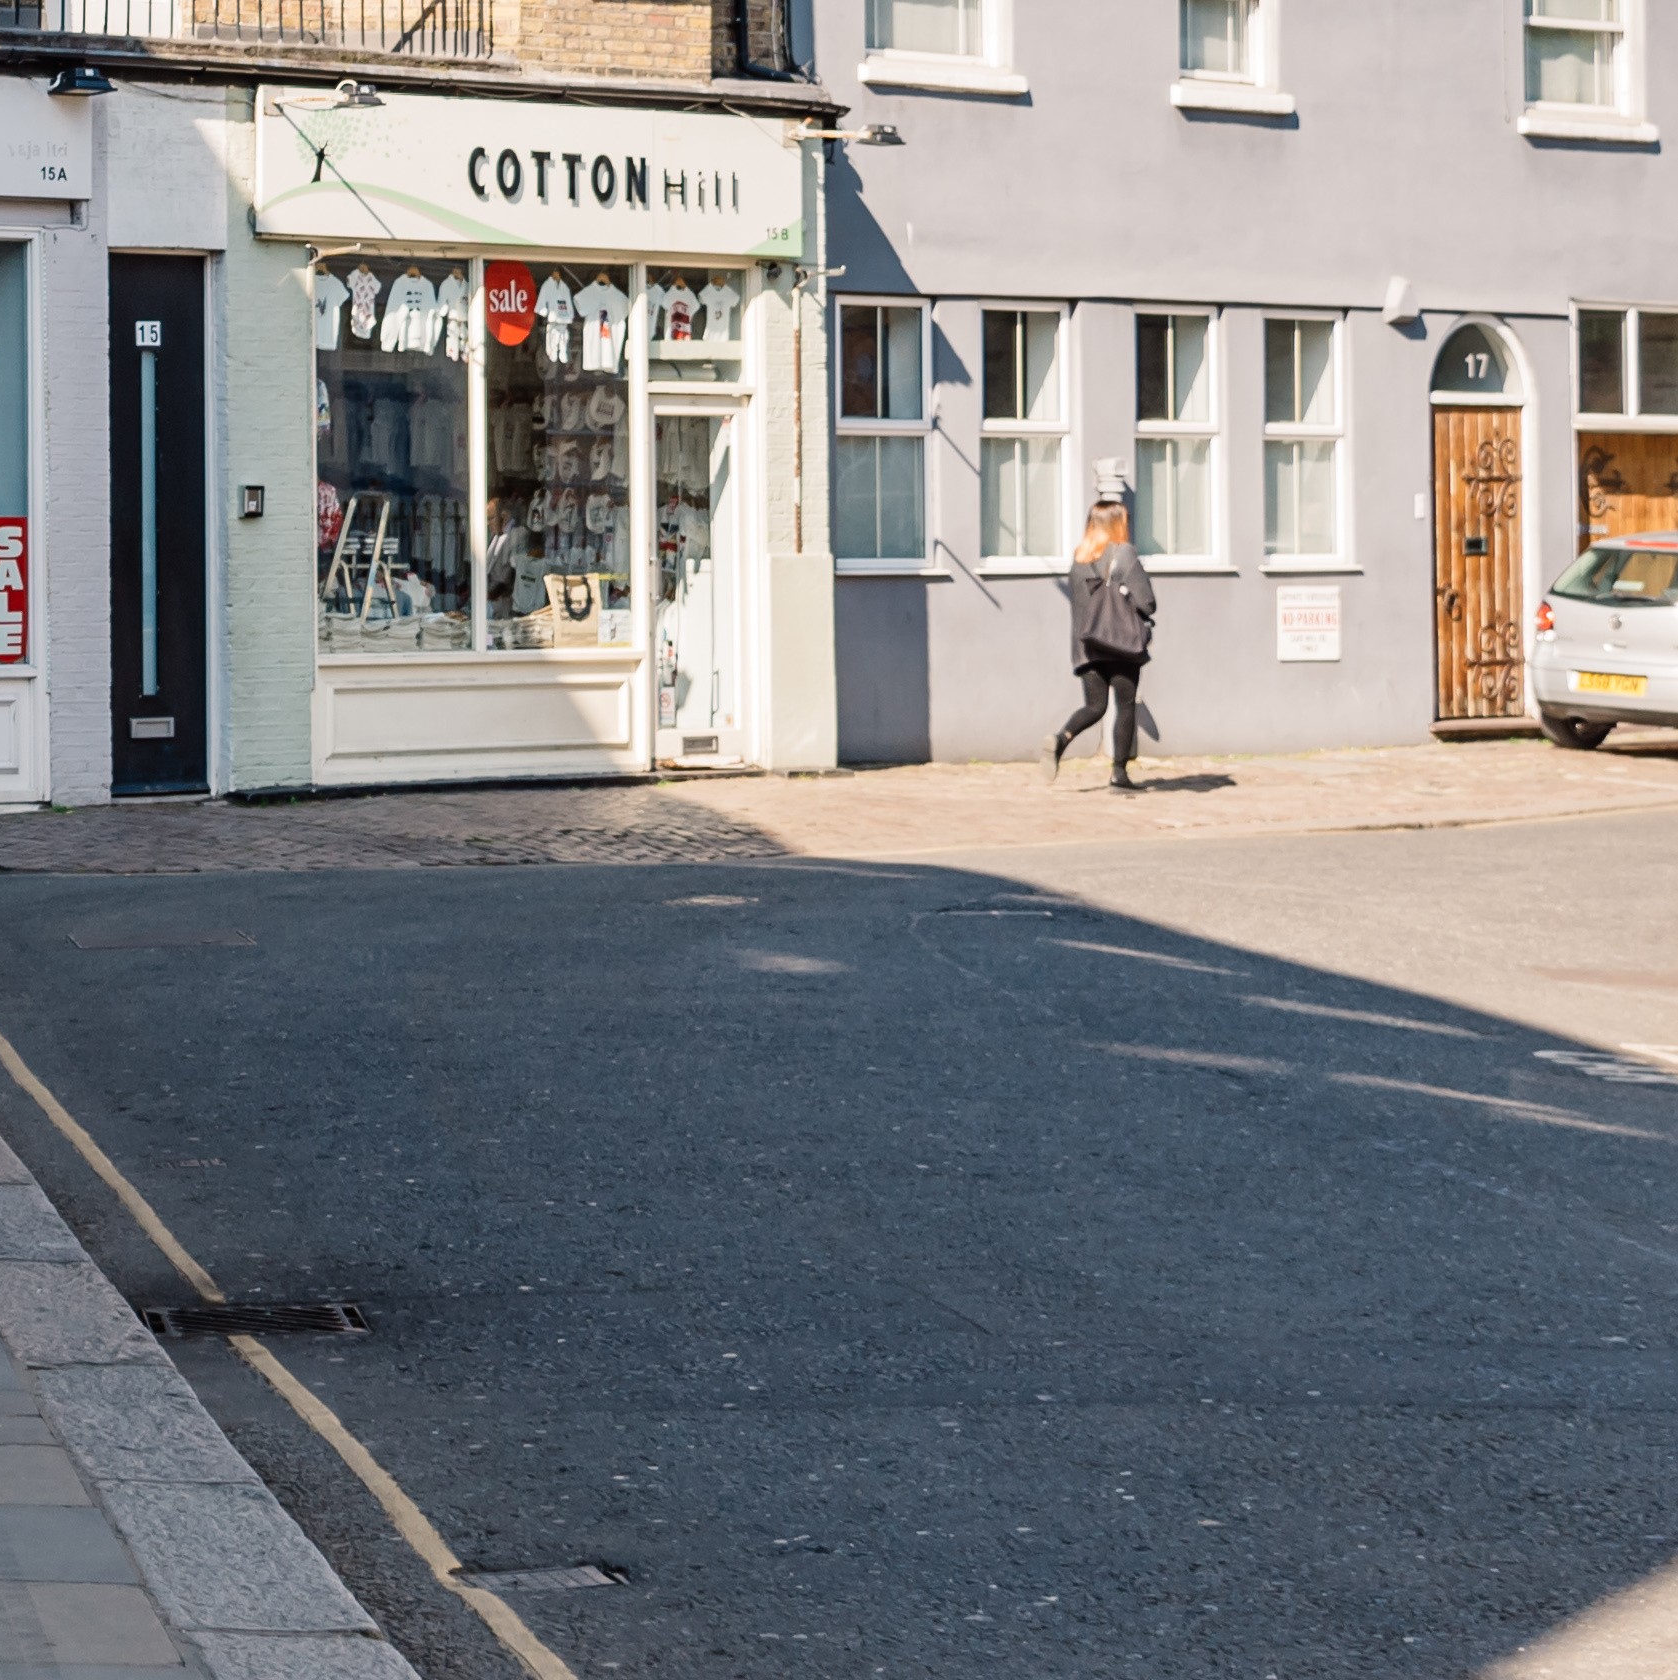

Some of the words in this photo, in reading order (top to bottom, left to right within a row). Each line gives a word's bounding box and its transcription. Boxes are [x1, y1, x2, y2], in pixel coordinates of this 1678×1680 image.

[40, 166, 68, 181] 15A
[467, 146, 648, 206] COTTON
[663, 169, 740, 212] Hill
[489, 279, 530, 315] sale
[137, 324, 160, 343] 15
[1464, 352, 1490, 379] 17
[1297, 611, 1338, 626] PARKING
